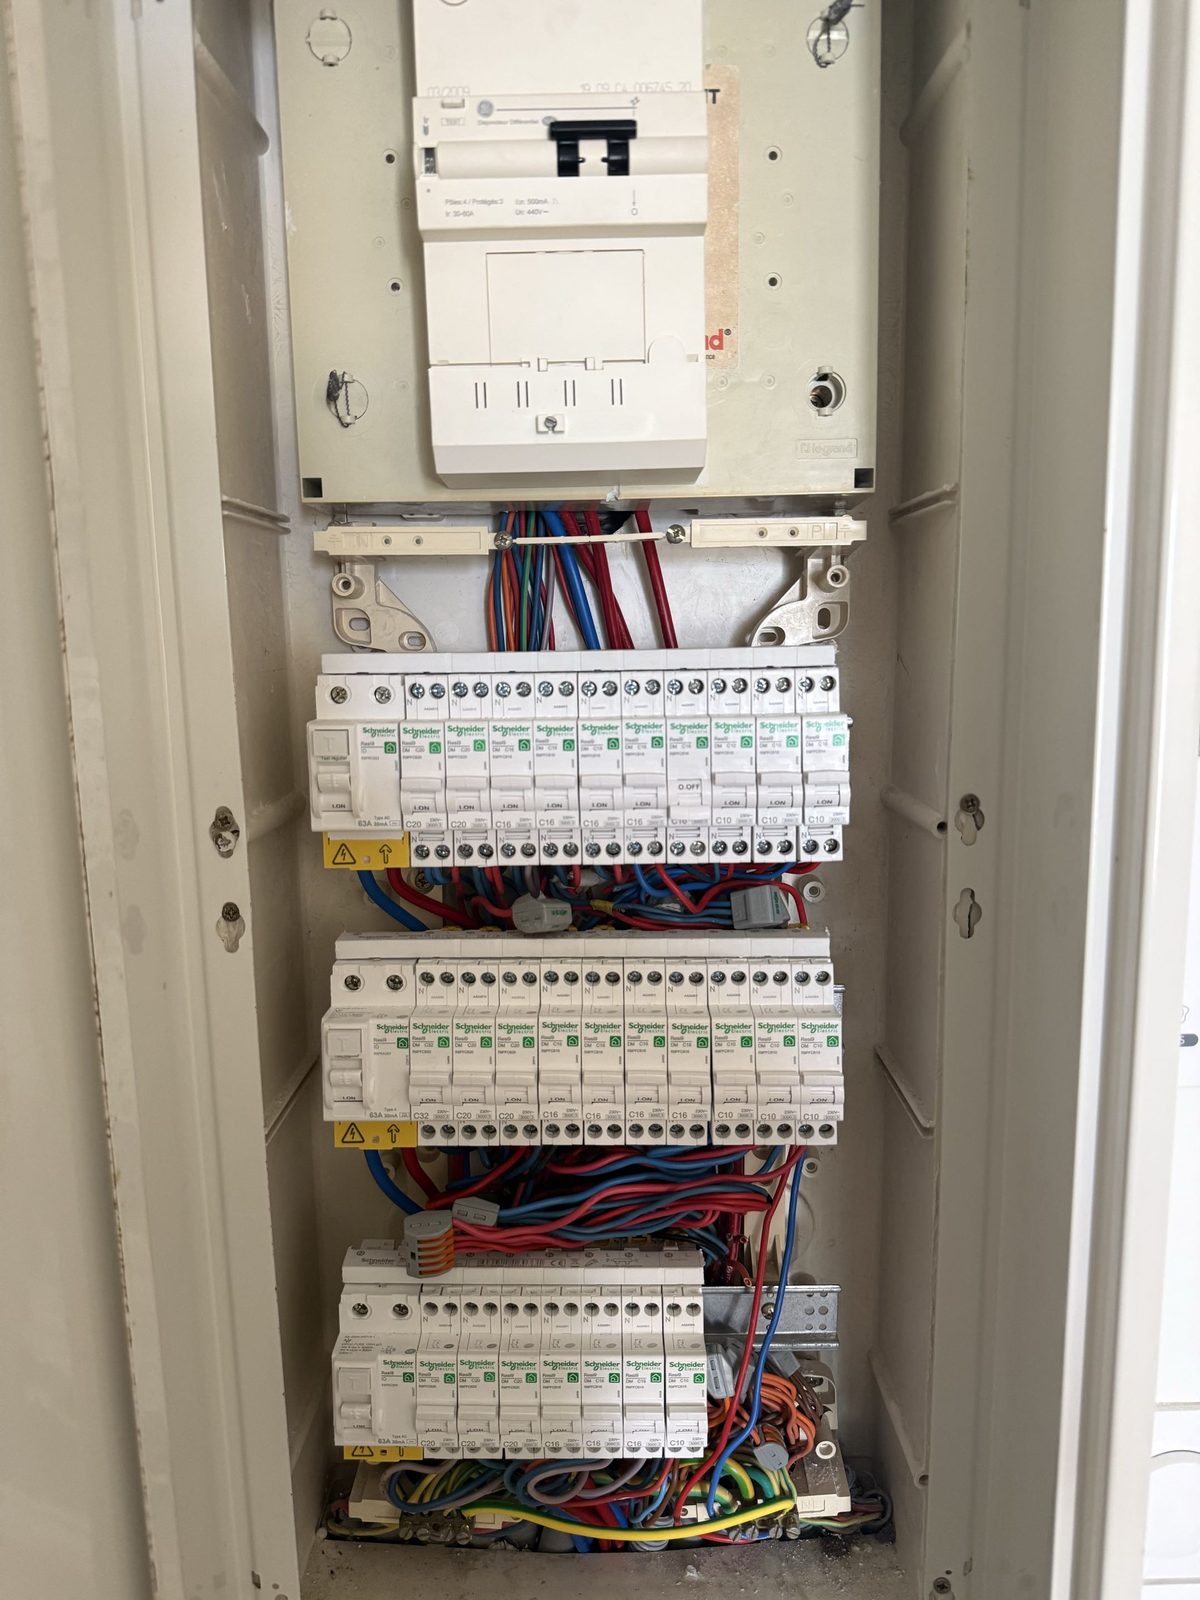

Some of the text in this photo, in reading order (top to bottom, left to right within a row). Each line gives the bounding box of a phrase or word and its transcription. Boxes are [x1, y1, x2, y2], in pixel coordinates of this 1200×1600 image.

[362, 726, 396, 737] Schneider
[402, 727, 440, 738] Schneider
[448, 725, 485, 736] Schneider
[492, 725, 530, 736] Schneider
[537, 724, 574, 736] Schneider
[581, 724, 619, 735] Schneider
[625, 722, 663, 734] Schneider
[670, 722, 708, 734] Schneider
[377, 1024, 408, 1033] Schneider
[413, 1023, 449, 1034] Schneider
[455, 1023, 492, 1034] Schneider
[498, 1023, 535, 1034] Schneider
[542, 1022, 578, 1033] Schneider
[585, 1022, 621, 1033] Schneider
[628, 1022, 665, 1033] Schneider
[672, 1023, 708, 1034] Schneider
[715, 1023, 752, 1034] Schneider
[758, 1022, 795, 1033] Schneider
[801, 1022, 838, 1033] Schneider
[383, 1360, 413, 1368] Schneider
[420, 1361, 455, 1371] Schneider
[460, 1360, 495, 1369] Schneider
[501, 1360, 536, 1370] Schneider
[543, 1360, 578, 1370] Schneider
[585, 1360, 620, 1371] Schneider
[626, 1360, 662, 1370] Schneider
[669, 1362, 704, 1371] Schneider
